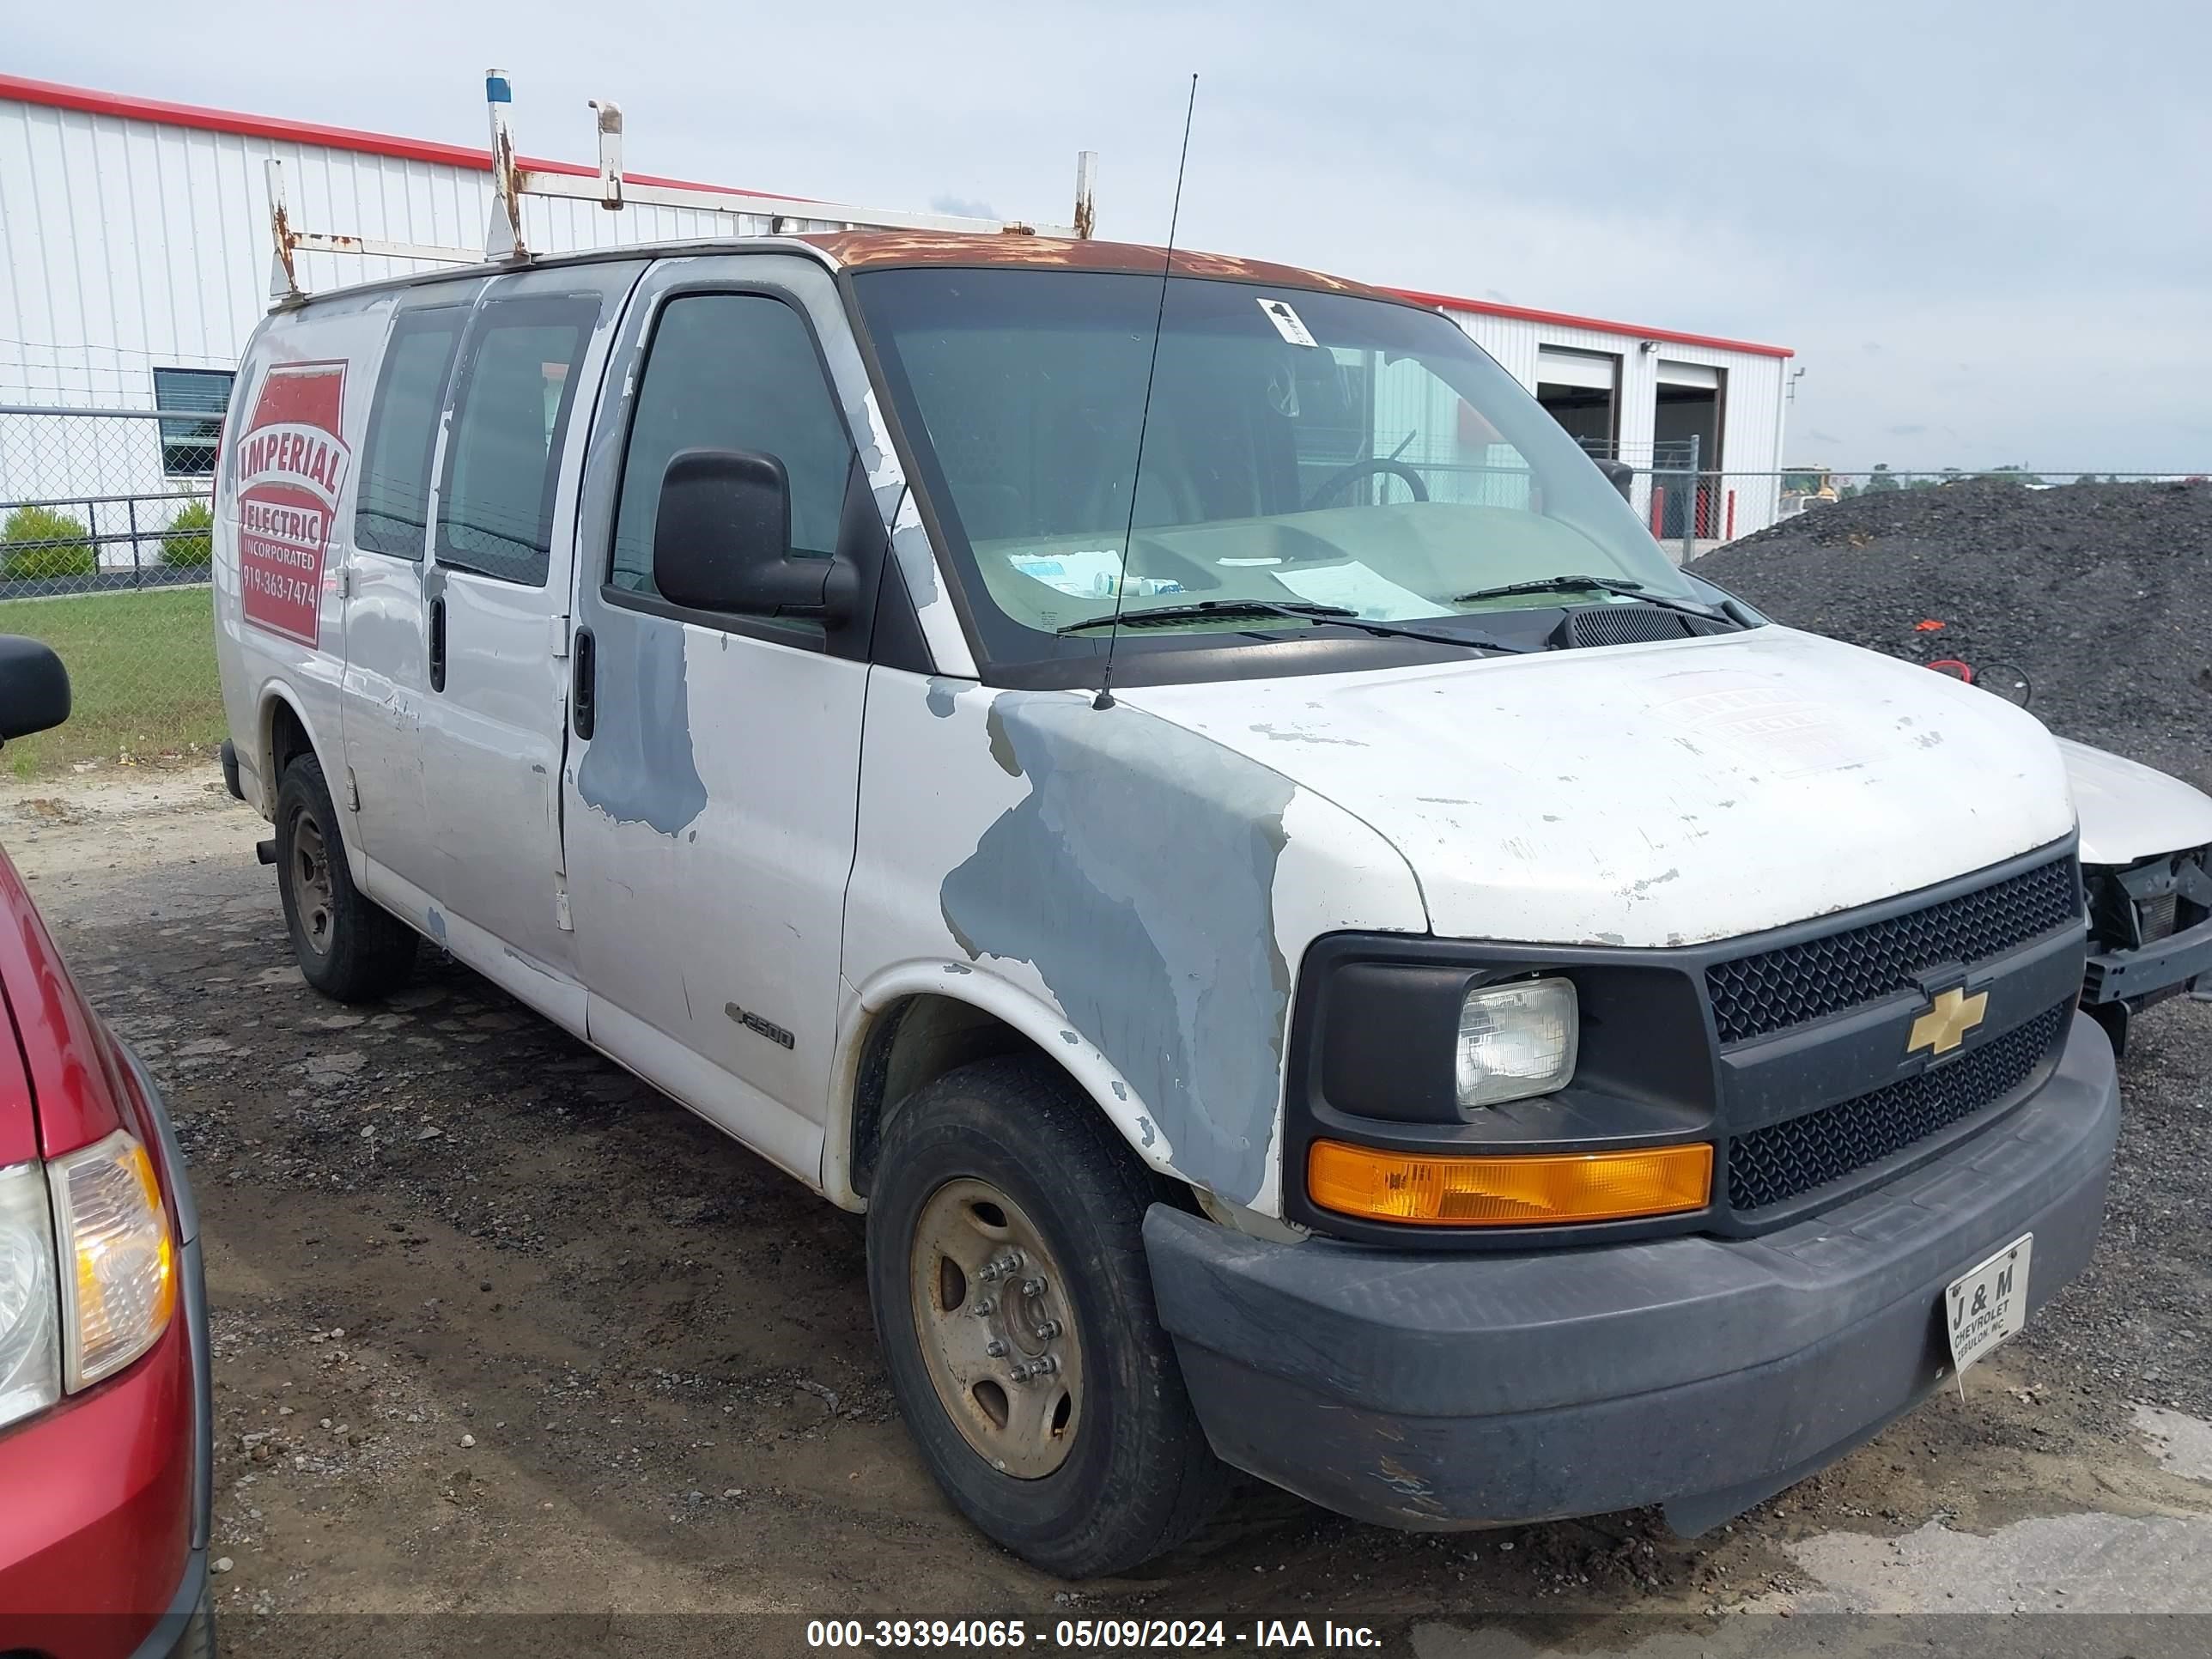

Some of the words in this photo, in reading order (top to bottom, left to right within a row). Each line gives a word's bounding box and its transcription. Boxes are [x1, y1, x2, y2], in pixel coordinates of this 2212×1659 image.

[241, 433, 340, 495] IMPERIAL
[246, 505, 319, 544] ELECTRIC
[244, 538, 316, 571] INCORPORATED
[243, 565, 317, 609] 919-363-7474
[744, 1012, 794, 1049] 2500
[1953, 1296, 1965, 1330] J
[1971, 1284, 1988, 1316] &
[1996, 1263, 2014, 1301] M
[1954, 1298, 2010, 1349] CHEVROLET
